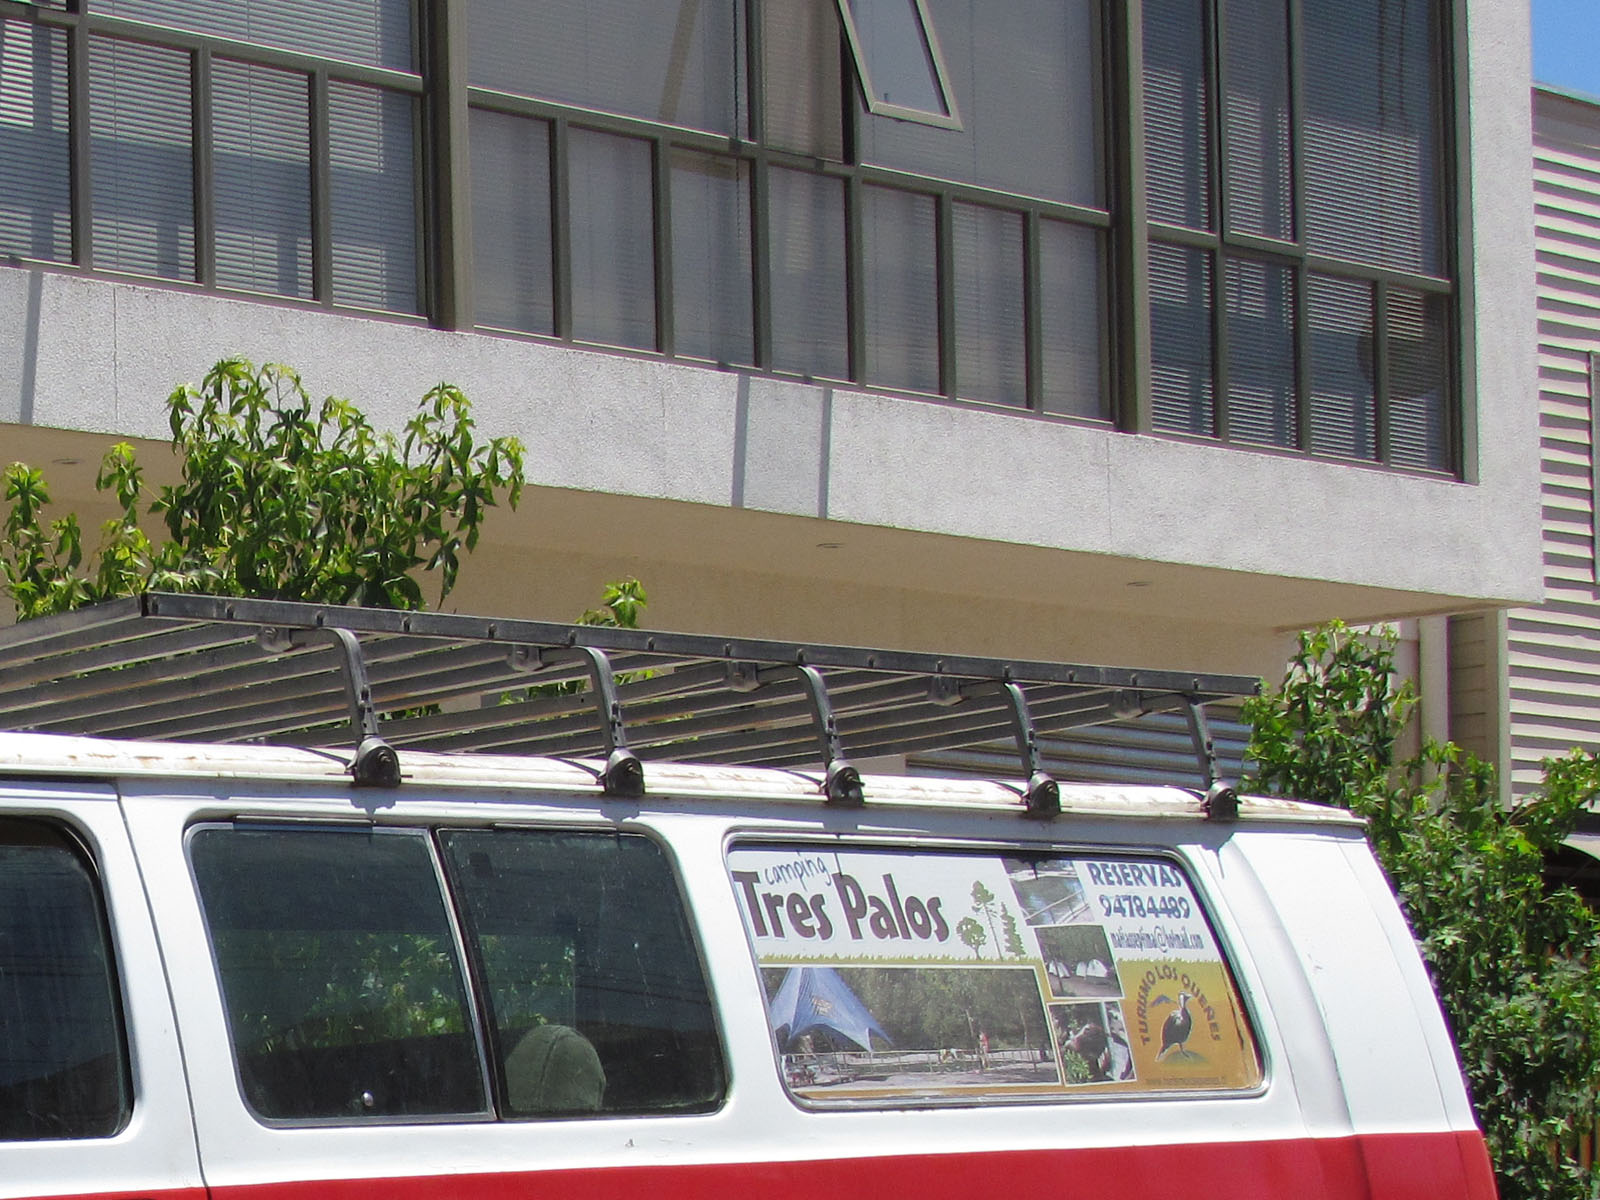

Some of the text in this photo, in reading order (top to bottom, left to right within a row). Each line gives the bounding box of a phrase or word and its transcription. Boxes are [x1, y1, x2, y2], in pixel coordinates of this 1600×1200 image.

[765, 857, 831, 890] camping
[1086, 863, 1183, 887] RESERVAS
[732, 871, 950, 943] Tres Palos
[1099, 894, 1191, 919] 94784489
[1154, 964, 1178, 981] LOS
